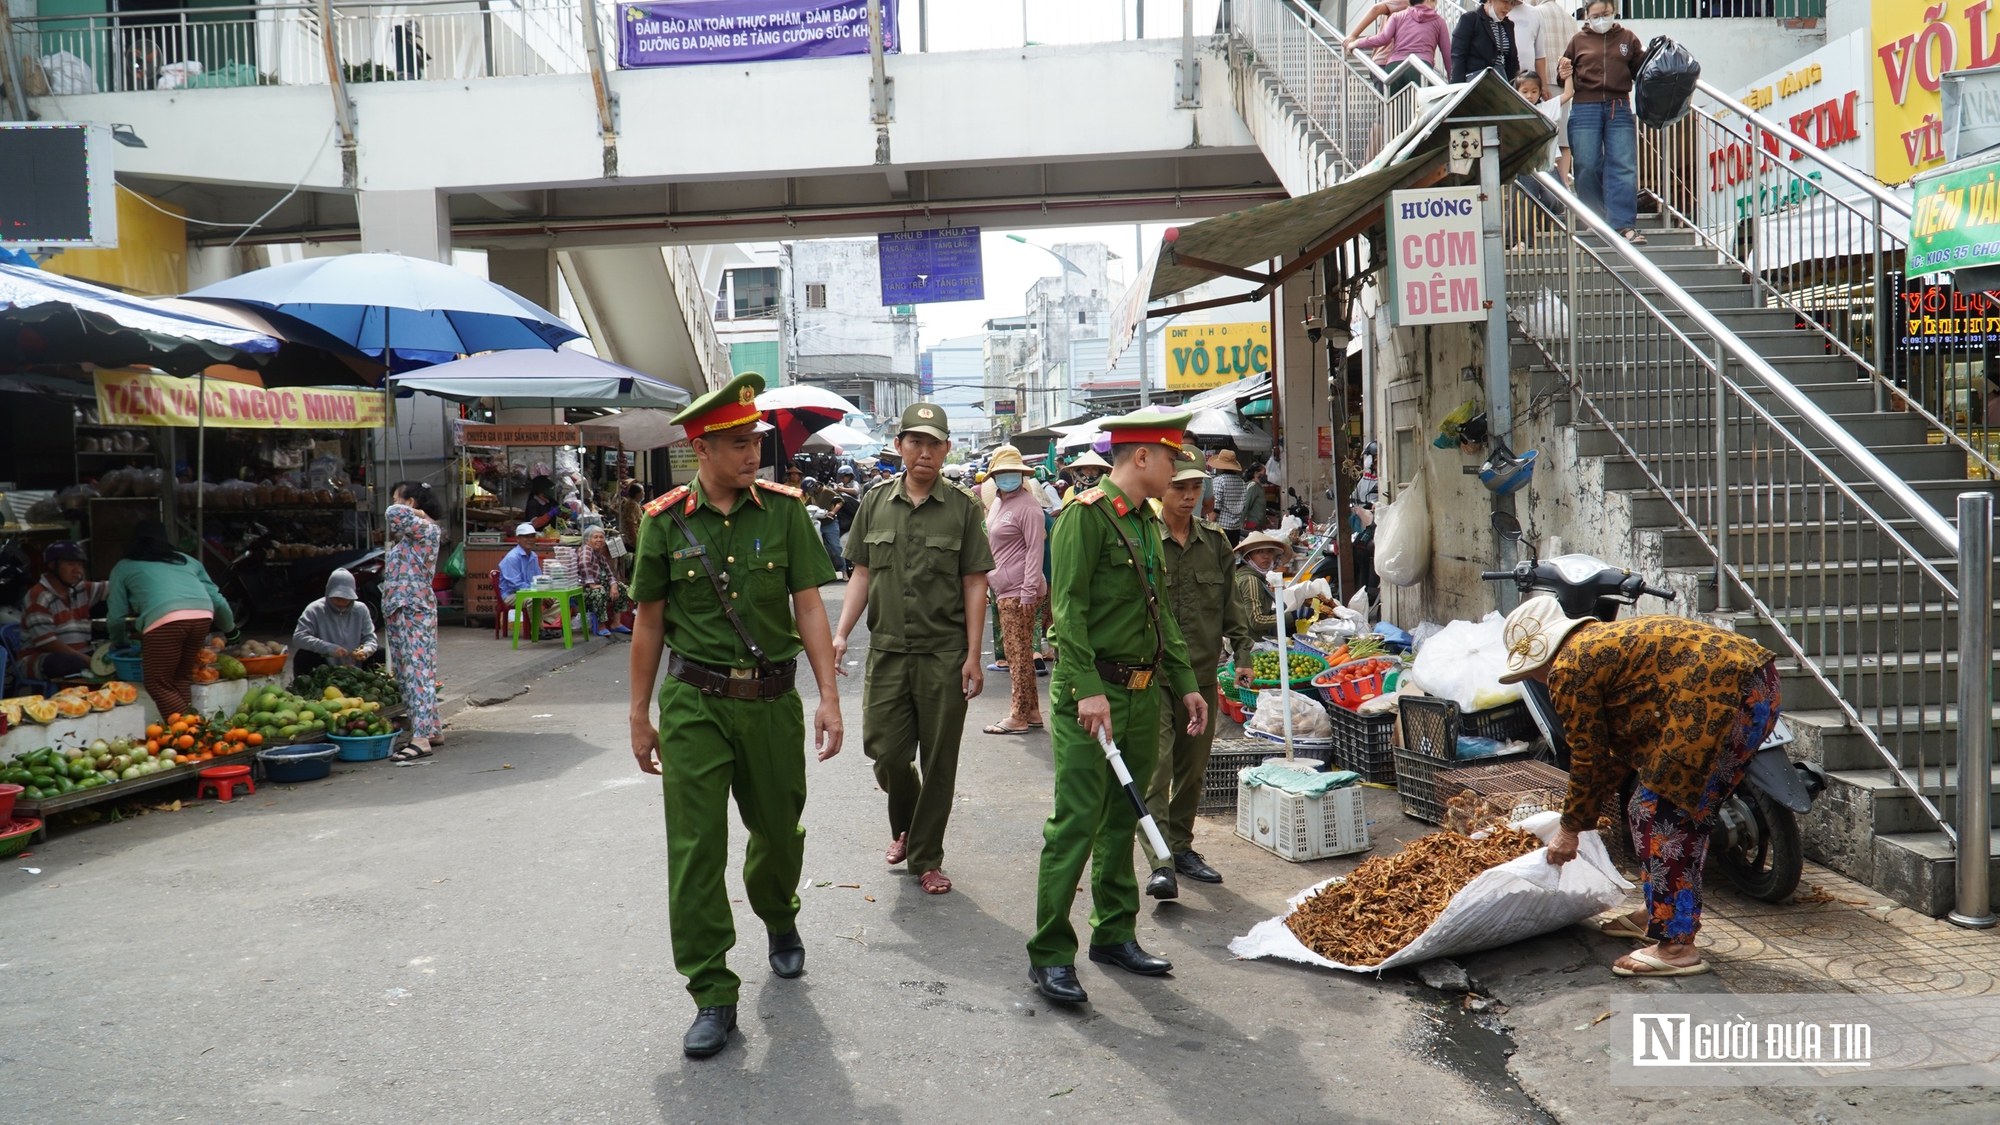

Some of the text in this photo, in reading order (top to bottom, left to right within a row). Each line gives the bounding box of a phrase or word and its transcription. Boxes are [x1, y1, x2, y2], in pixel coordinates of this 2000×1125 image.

[636, 20, 659, 35] ĐẢM
[662, 18, 685, 34] BẢO
[687, 19, 702, 32] AN
[704, 15, 733, 30] TOÀN
[737, 15, 767, 30] THỰC
[806, 8, 831, 24] ĐẢM
[833, 6, 857, 21] BẢO
[640, 36, 680, 52] DƯỠNG
[682, 37, 698, 49] ĐA
[700, 35, 730, 51] DẠNG
[733, 30, 748, 46] ĐỂ
[750, 30, 780, 45] TĂNG
[783, 24, 823, 42] CƯỜNG
[826, 23, 850, 39] SỨC
[1878, 2, 1958, 106] VÕ
[1776, 63, 1822, 99] VÀNG
[1789, 90, 1861, 161] KIM
[1401, 197, 1473, 220] HƯƠNG
[1914, 184, 1964, 245] TIỆM
[894, 232, 914, 240] KHU
[938, 228, 968, 237] KHU A
[1403, 229, 1477, 270] CƠM
[1926, 249, 1951, 266] KIOS
[1953, 246, 1969, 260] 35
[1406, 272, 1479, 316] ĐÊM
[1172, 338, 1268, 380] VÕ LỰC
[104, 379, 357, 427] TIỆM VÀNG NGỌC MINH
